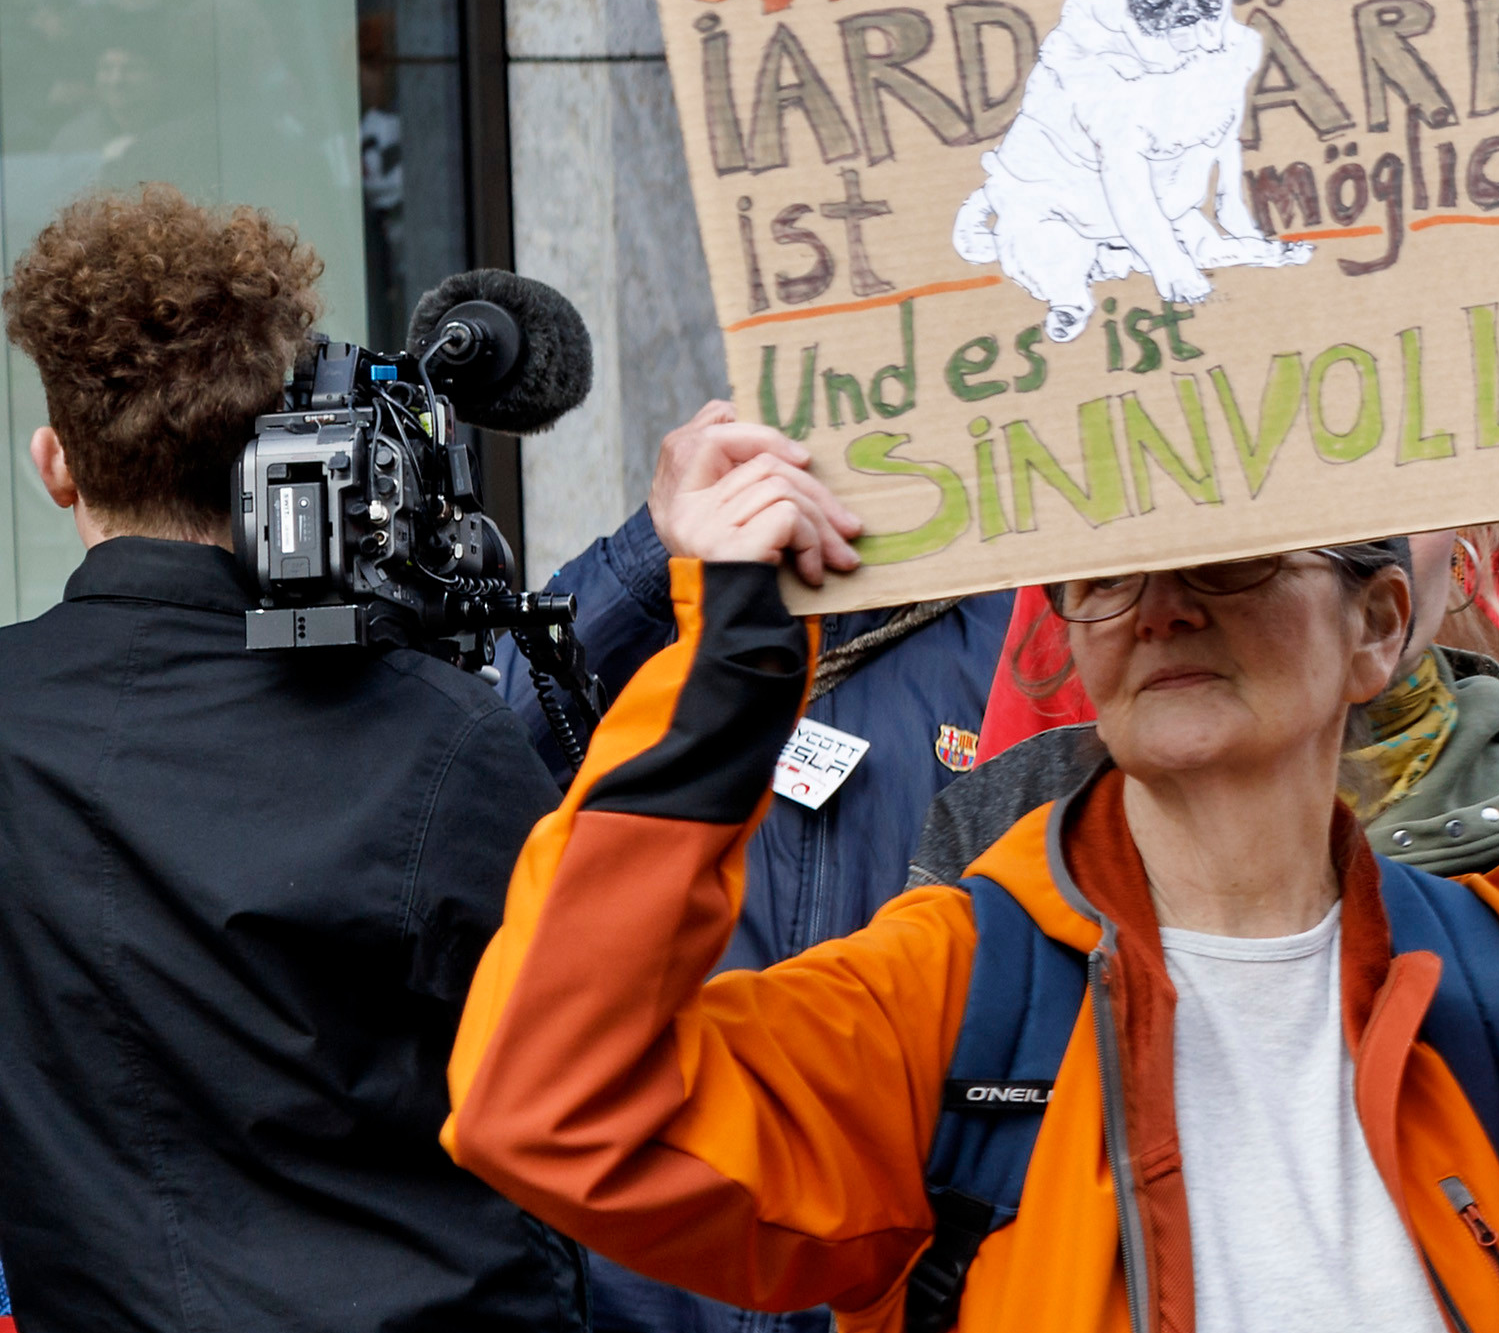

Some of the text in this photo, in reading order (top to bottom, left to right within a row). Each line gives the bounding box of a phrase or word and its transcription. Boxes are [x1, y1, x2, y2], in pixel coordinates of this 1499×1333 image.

[735, 166, 897, 315] ist
[757, 295, 1205, 441] Und es ist
[779, 741, 850, 778] ESLA
[796, 728, 860, 759] YCOTT
